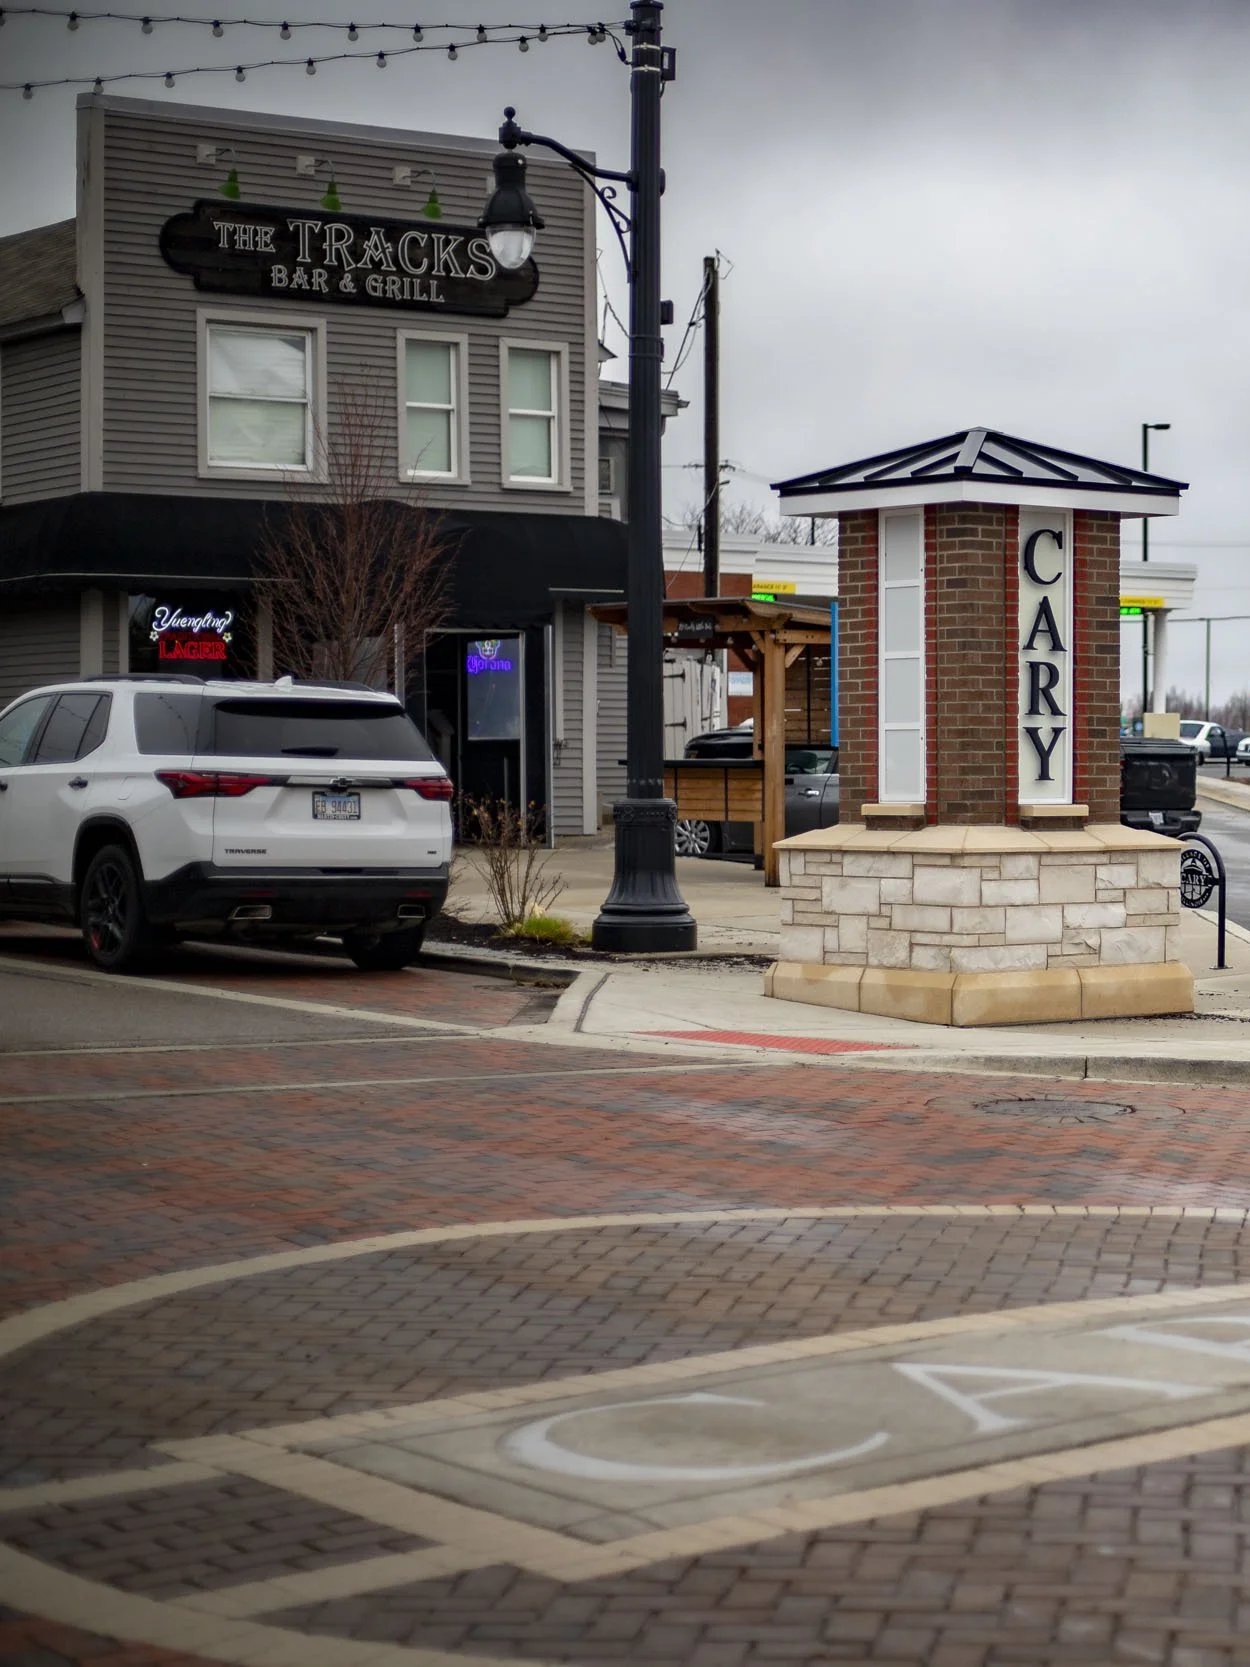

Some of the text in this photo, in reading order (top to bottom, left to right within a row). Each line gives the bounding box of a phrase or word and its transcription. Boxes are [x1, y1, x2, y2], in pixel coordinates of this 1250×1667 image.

[213, 218, 497, 281] THE TRACKS
[271, 264, 445, 303] BAR & GRILL
[152, 606, 232, 633] Yuengling
[159, 640, 227, 660] LAGER
[1022, 528, 1068, 781] CARY
[1181, 873, 1207, 886] CARY
